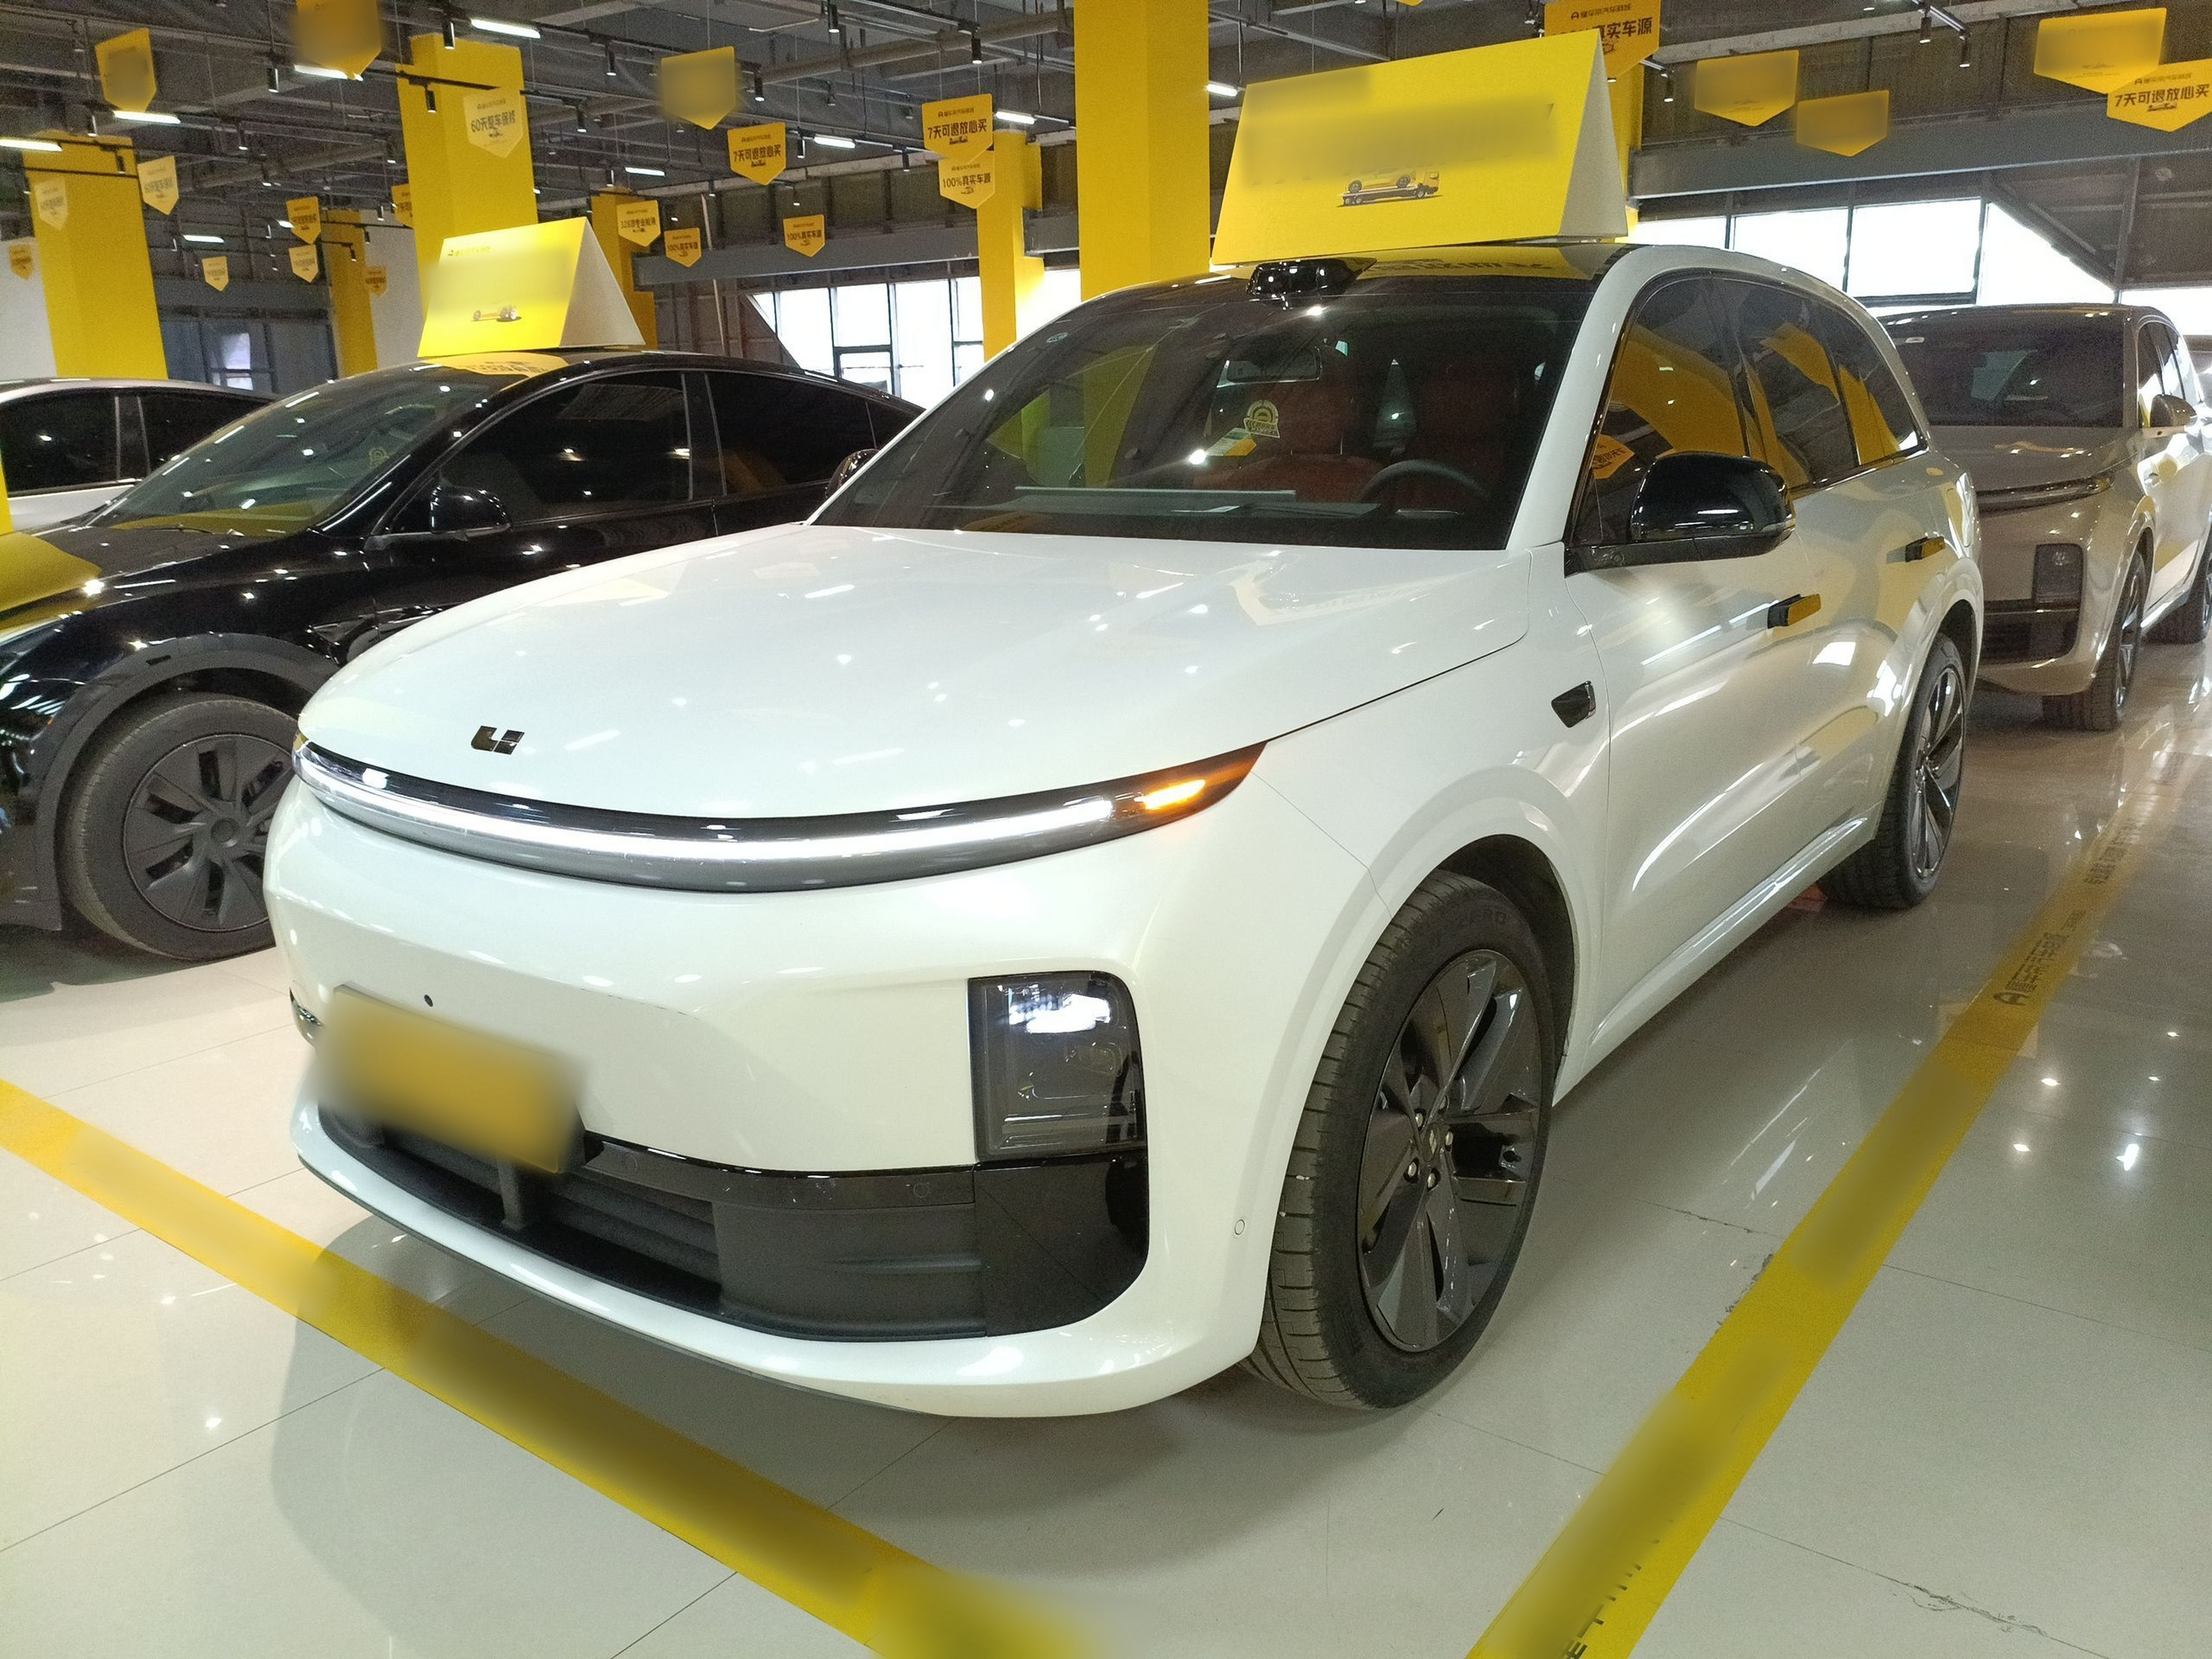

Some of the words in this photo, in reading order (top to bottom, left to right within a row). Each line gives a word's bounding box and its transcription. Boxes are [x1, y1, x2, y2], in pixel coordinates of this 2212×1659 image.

[1560, 17, 1653, 39] 真实车源
[2115, 84, 2210, 107] 7天可退放心买
[927, 119, 987, 139] 7天可退放心买
